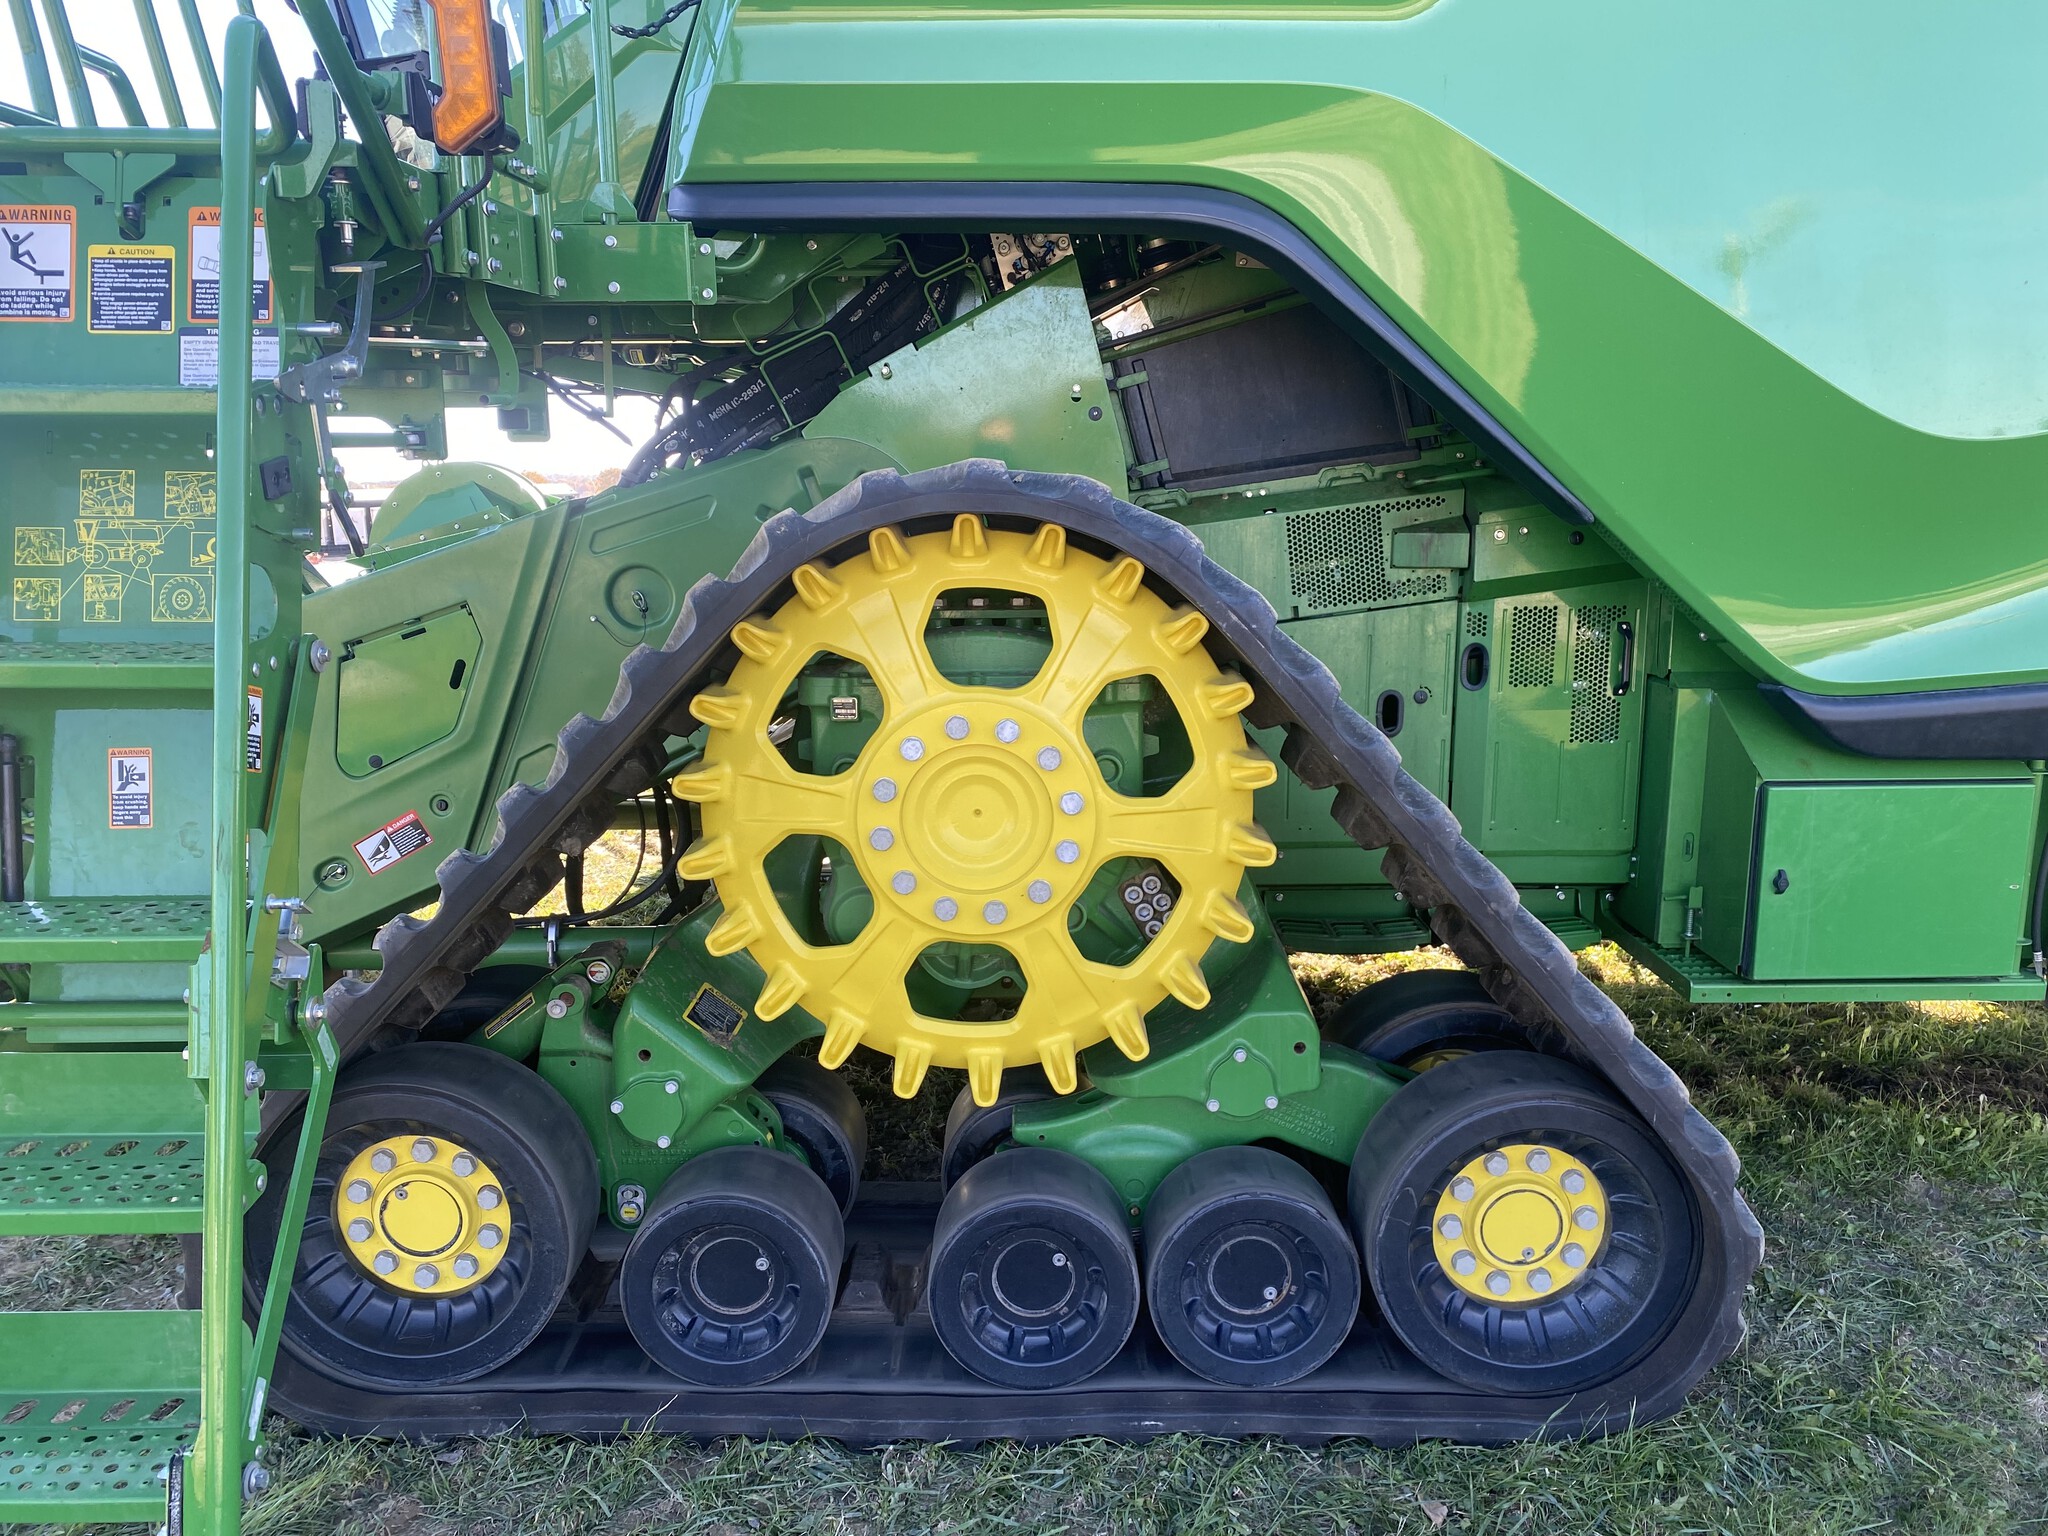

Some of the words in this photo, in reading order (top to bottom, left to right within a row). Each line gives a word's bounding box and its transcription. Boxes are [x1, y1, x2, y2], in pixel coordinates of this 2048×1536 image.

[9, 209, 71, 221] WARNING
[46, 289, 67, 298] injury
[708, 402, 733, 422] MSHA
[392, 813, 415, 829] DANGER
[716, 992, 743, 1013] CAUTION
